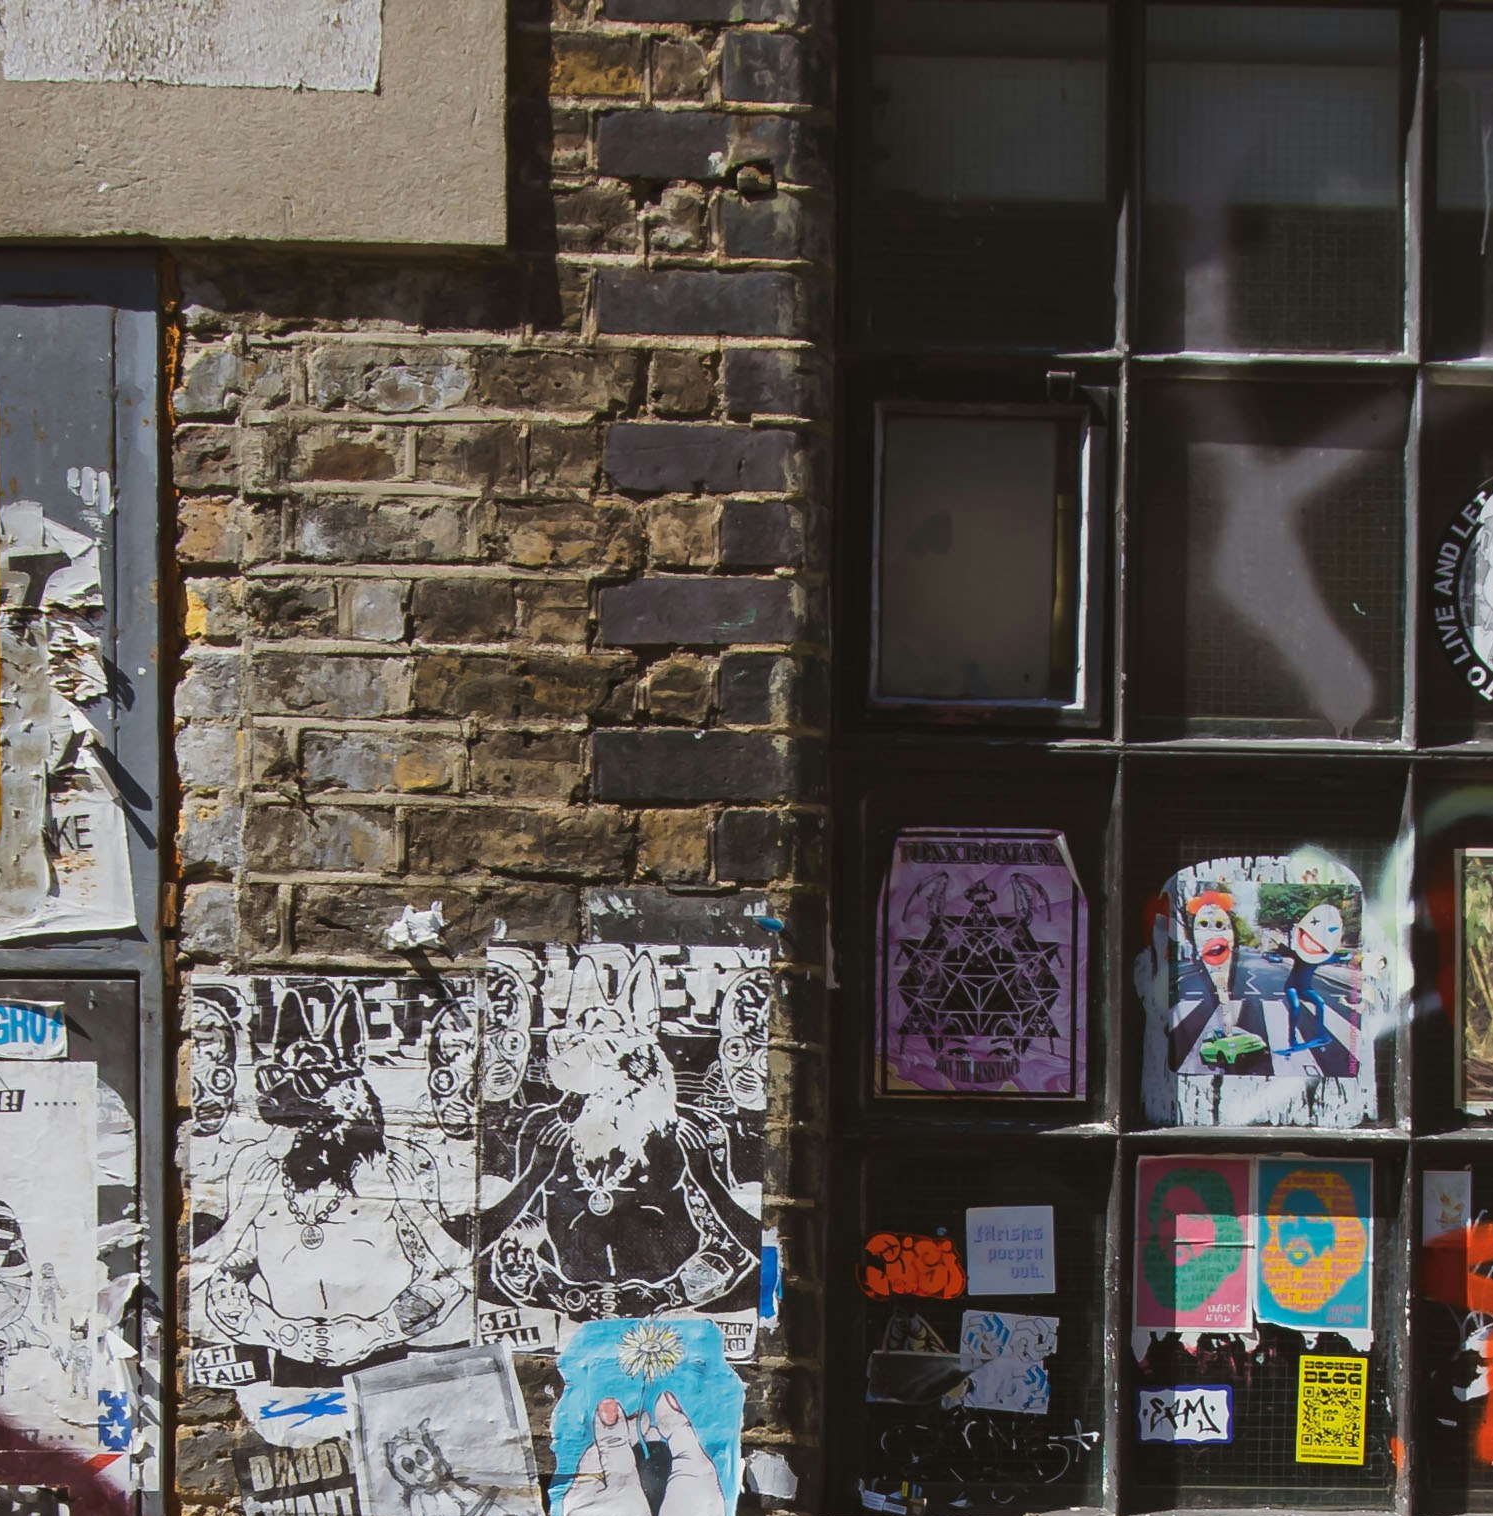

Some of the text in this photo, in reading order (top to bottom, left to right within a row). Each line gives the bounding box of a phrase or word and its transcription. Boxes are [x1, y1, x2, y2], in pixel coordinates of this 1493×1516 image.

[1450, 490, 1488, 540] LET
[1433, 541, 1462, 595] AND
[1434, 604, 1473, 666] LIVE
[198, 1361, 255, 1384] TALL
